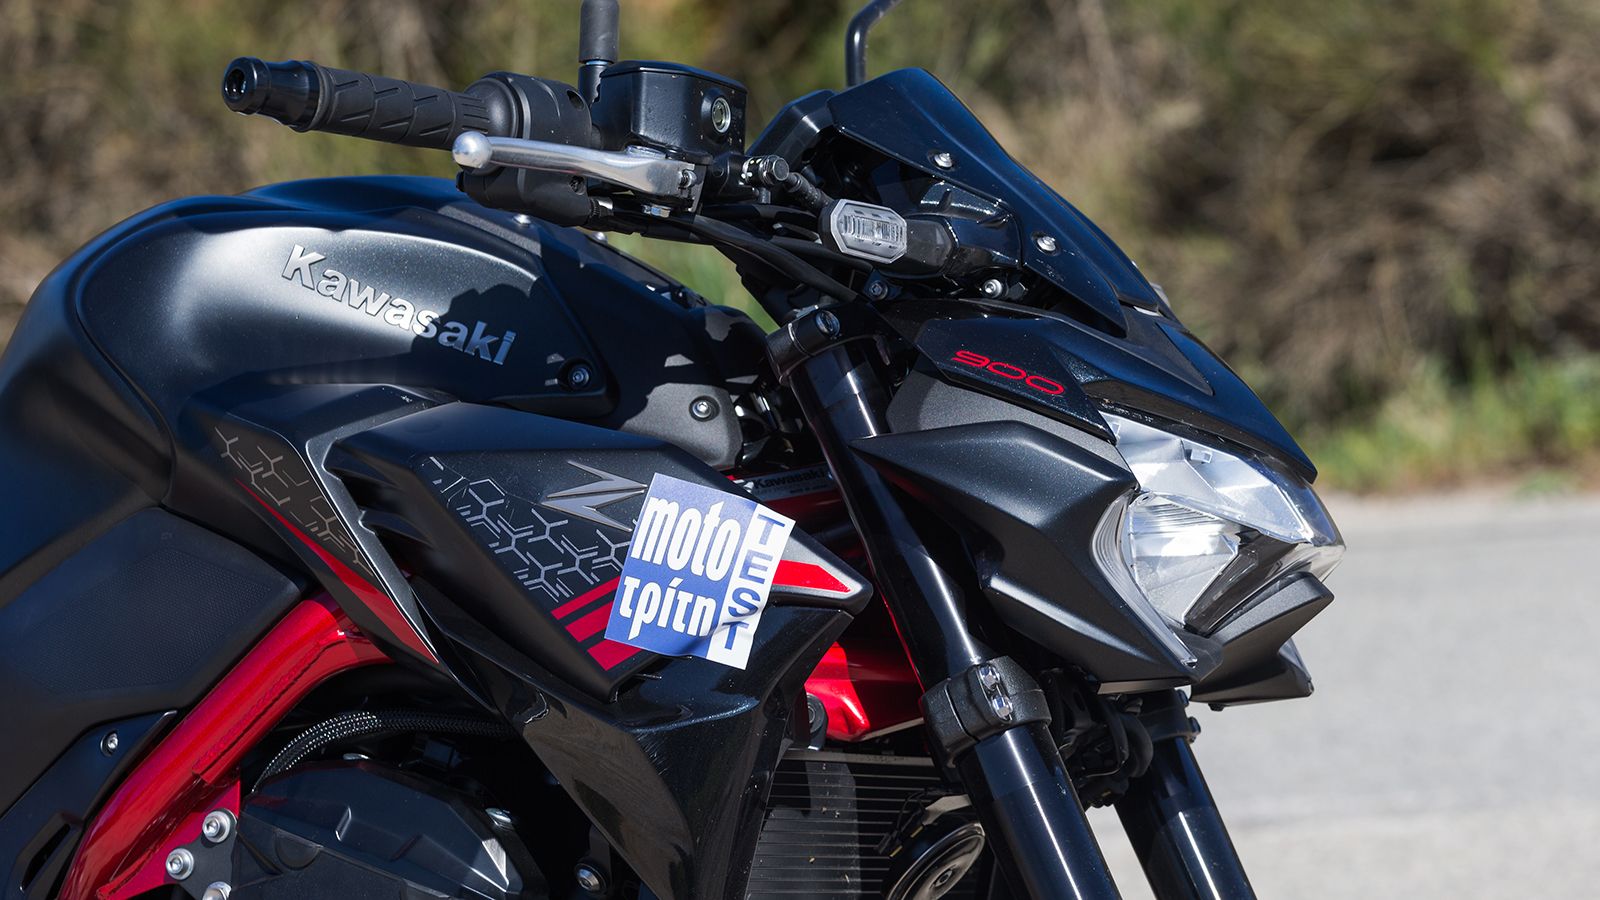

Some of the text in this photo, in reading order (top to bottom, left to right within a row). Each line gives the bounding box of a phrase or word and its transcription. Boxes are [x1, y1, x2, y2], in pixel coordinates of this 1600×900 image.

[282, 244, 517, 365] Kawasaki
[951, 350, 1065, 394] 900
[754, 468, 825, 488] Kawasaki
[631, 496, 741, 581] moto
[722, 514, 786, 650] TEST
